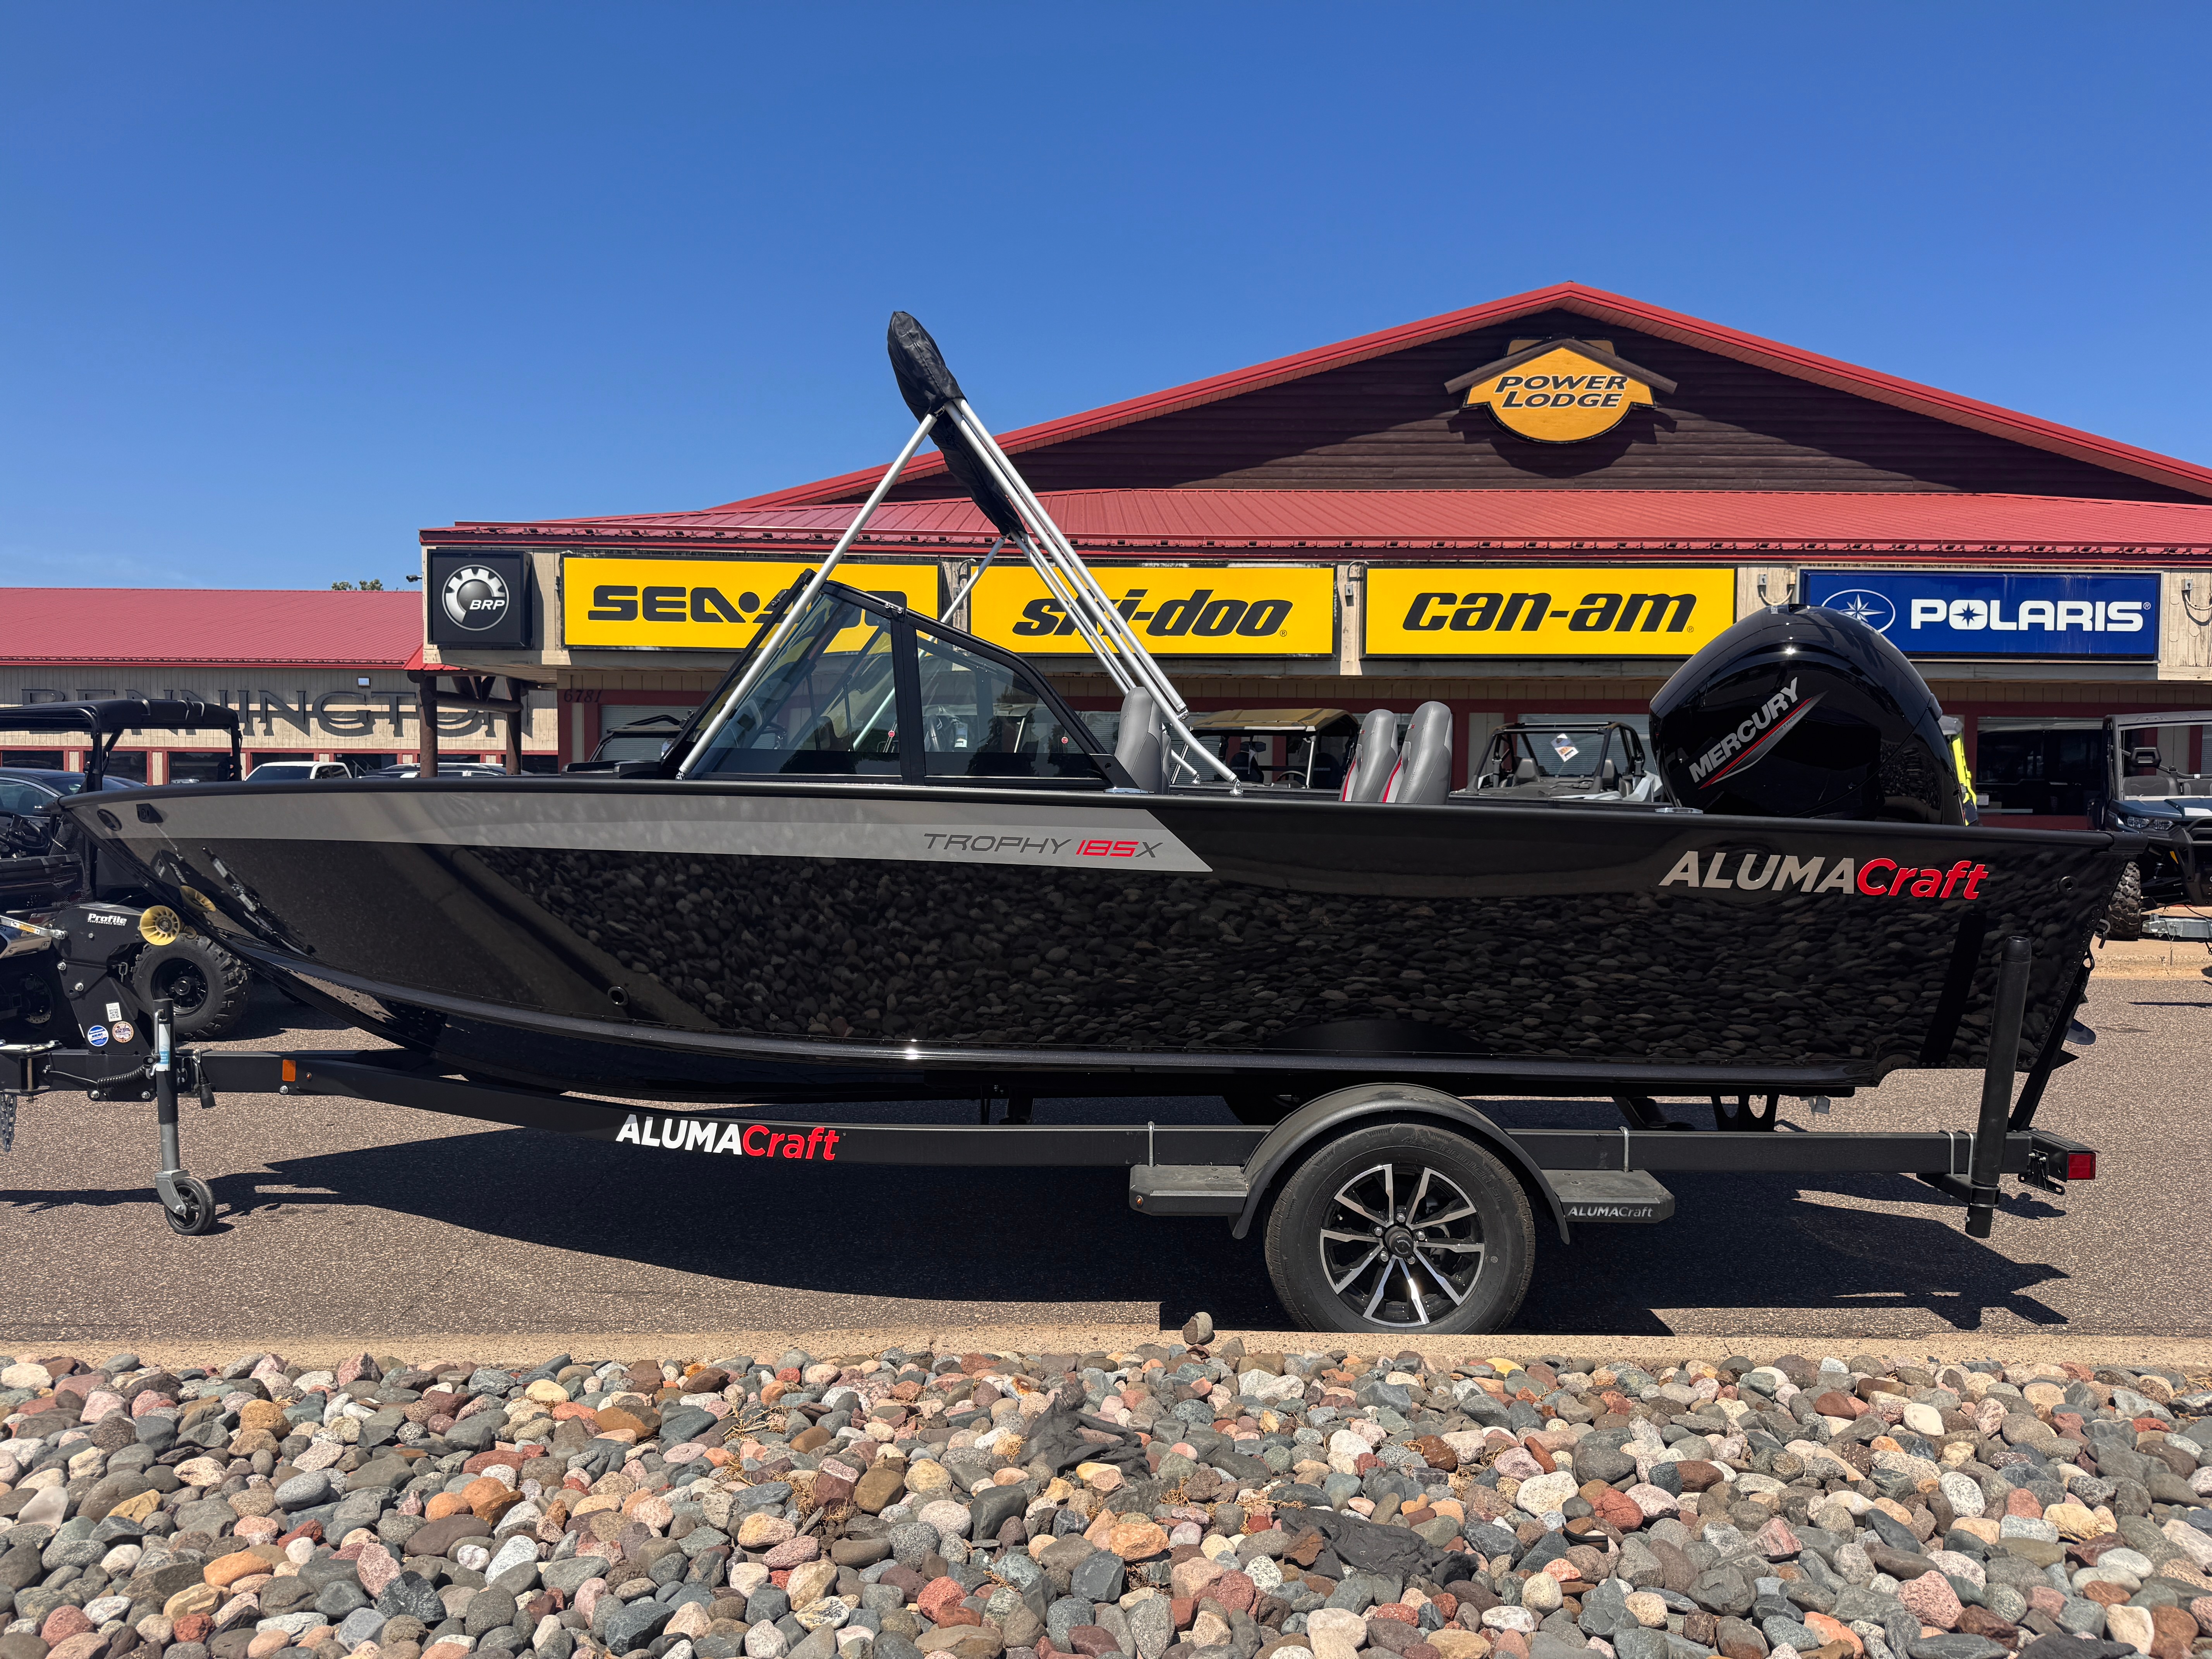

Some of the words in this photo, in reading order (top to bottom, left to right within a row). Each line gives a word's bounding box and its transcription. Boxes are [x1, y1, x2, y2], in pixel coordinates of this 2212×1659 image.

[1494, 374, 1628, 393] POWER
[1501, 391, 1623, 409] LODGE
[469, 599, 505, 611] BRP
[564, 689, 602, 703] 6781
[1688, 677, 1800, 783] MERCURY
[924, 833, 1072, 855] TROPHY
[1075, 839, 1164, 858] 185X
[1658, 850, 1989, 900] ALUMACraft
[88, 913, 127, 924] Profile
[615, 1113, 840, 1161] ALUMACraft
[1567, 1205, 1654, 1218] ALUMACraft
